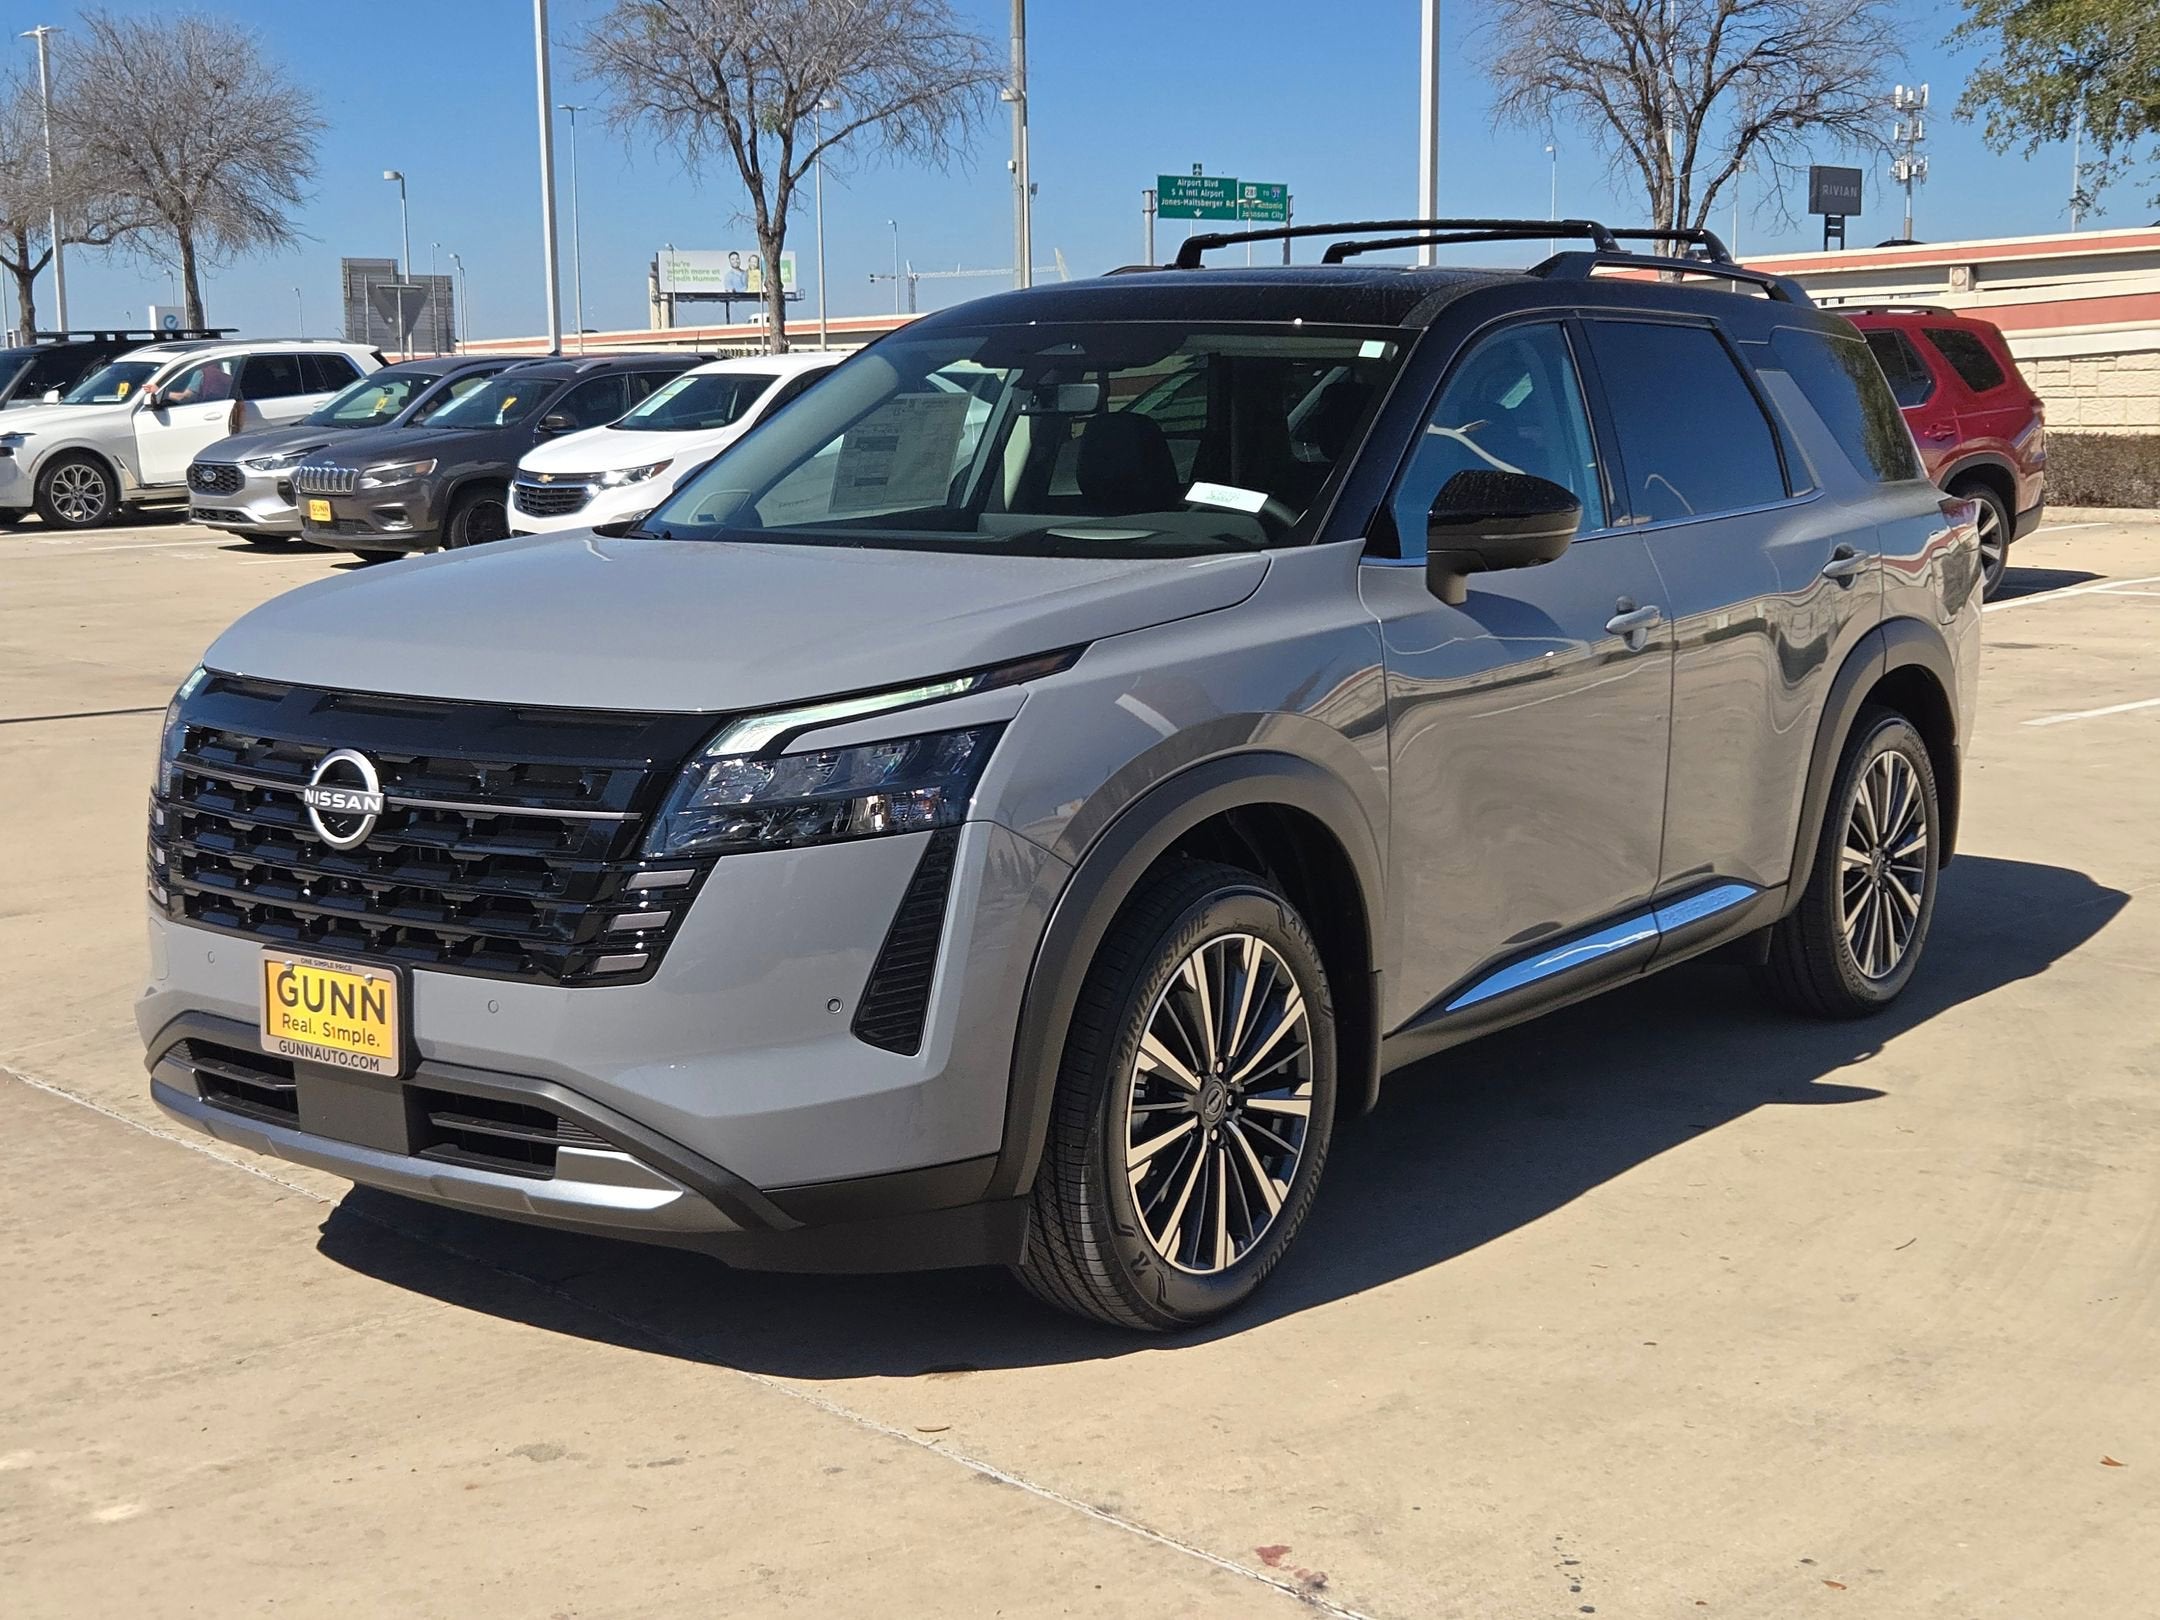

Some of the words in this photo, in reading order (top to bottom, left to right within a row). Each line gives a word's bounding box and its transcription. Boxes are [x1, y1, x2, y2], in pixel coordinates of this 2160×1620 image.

[1171, 188, 1176, 196] S
[1200, 190, 1224, 198] Airport
[1177, 178, 1201, 188] Airport
[1822, 184, 1857, 197] RIVIAN
[1161, 199, 1223, 209] Jones-Maltsberger
[304, 788, 381, 812] NISSAN
[1120, 909, 1210, 1060] BRIDGESTONE
[276, 969, 386, 1025] GUNN
[282, 1012, 316, 1035] Real.
[278, 1040, 380, 1072] GUNNAUTO.COM
